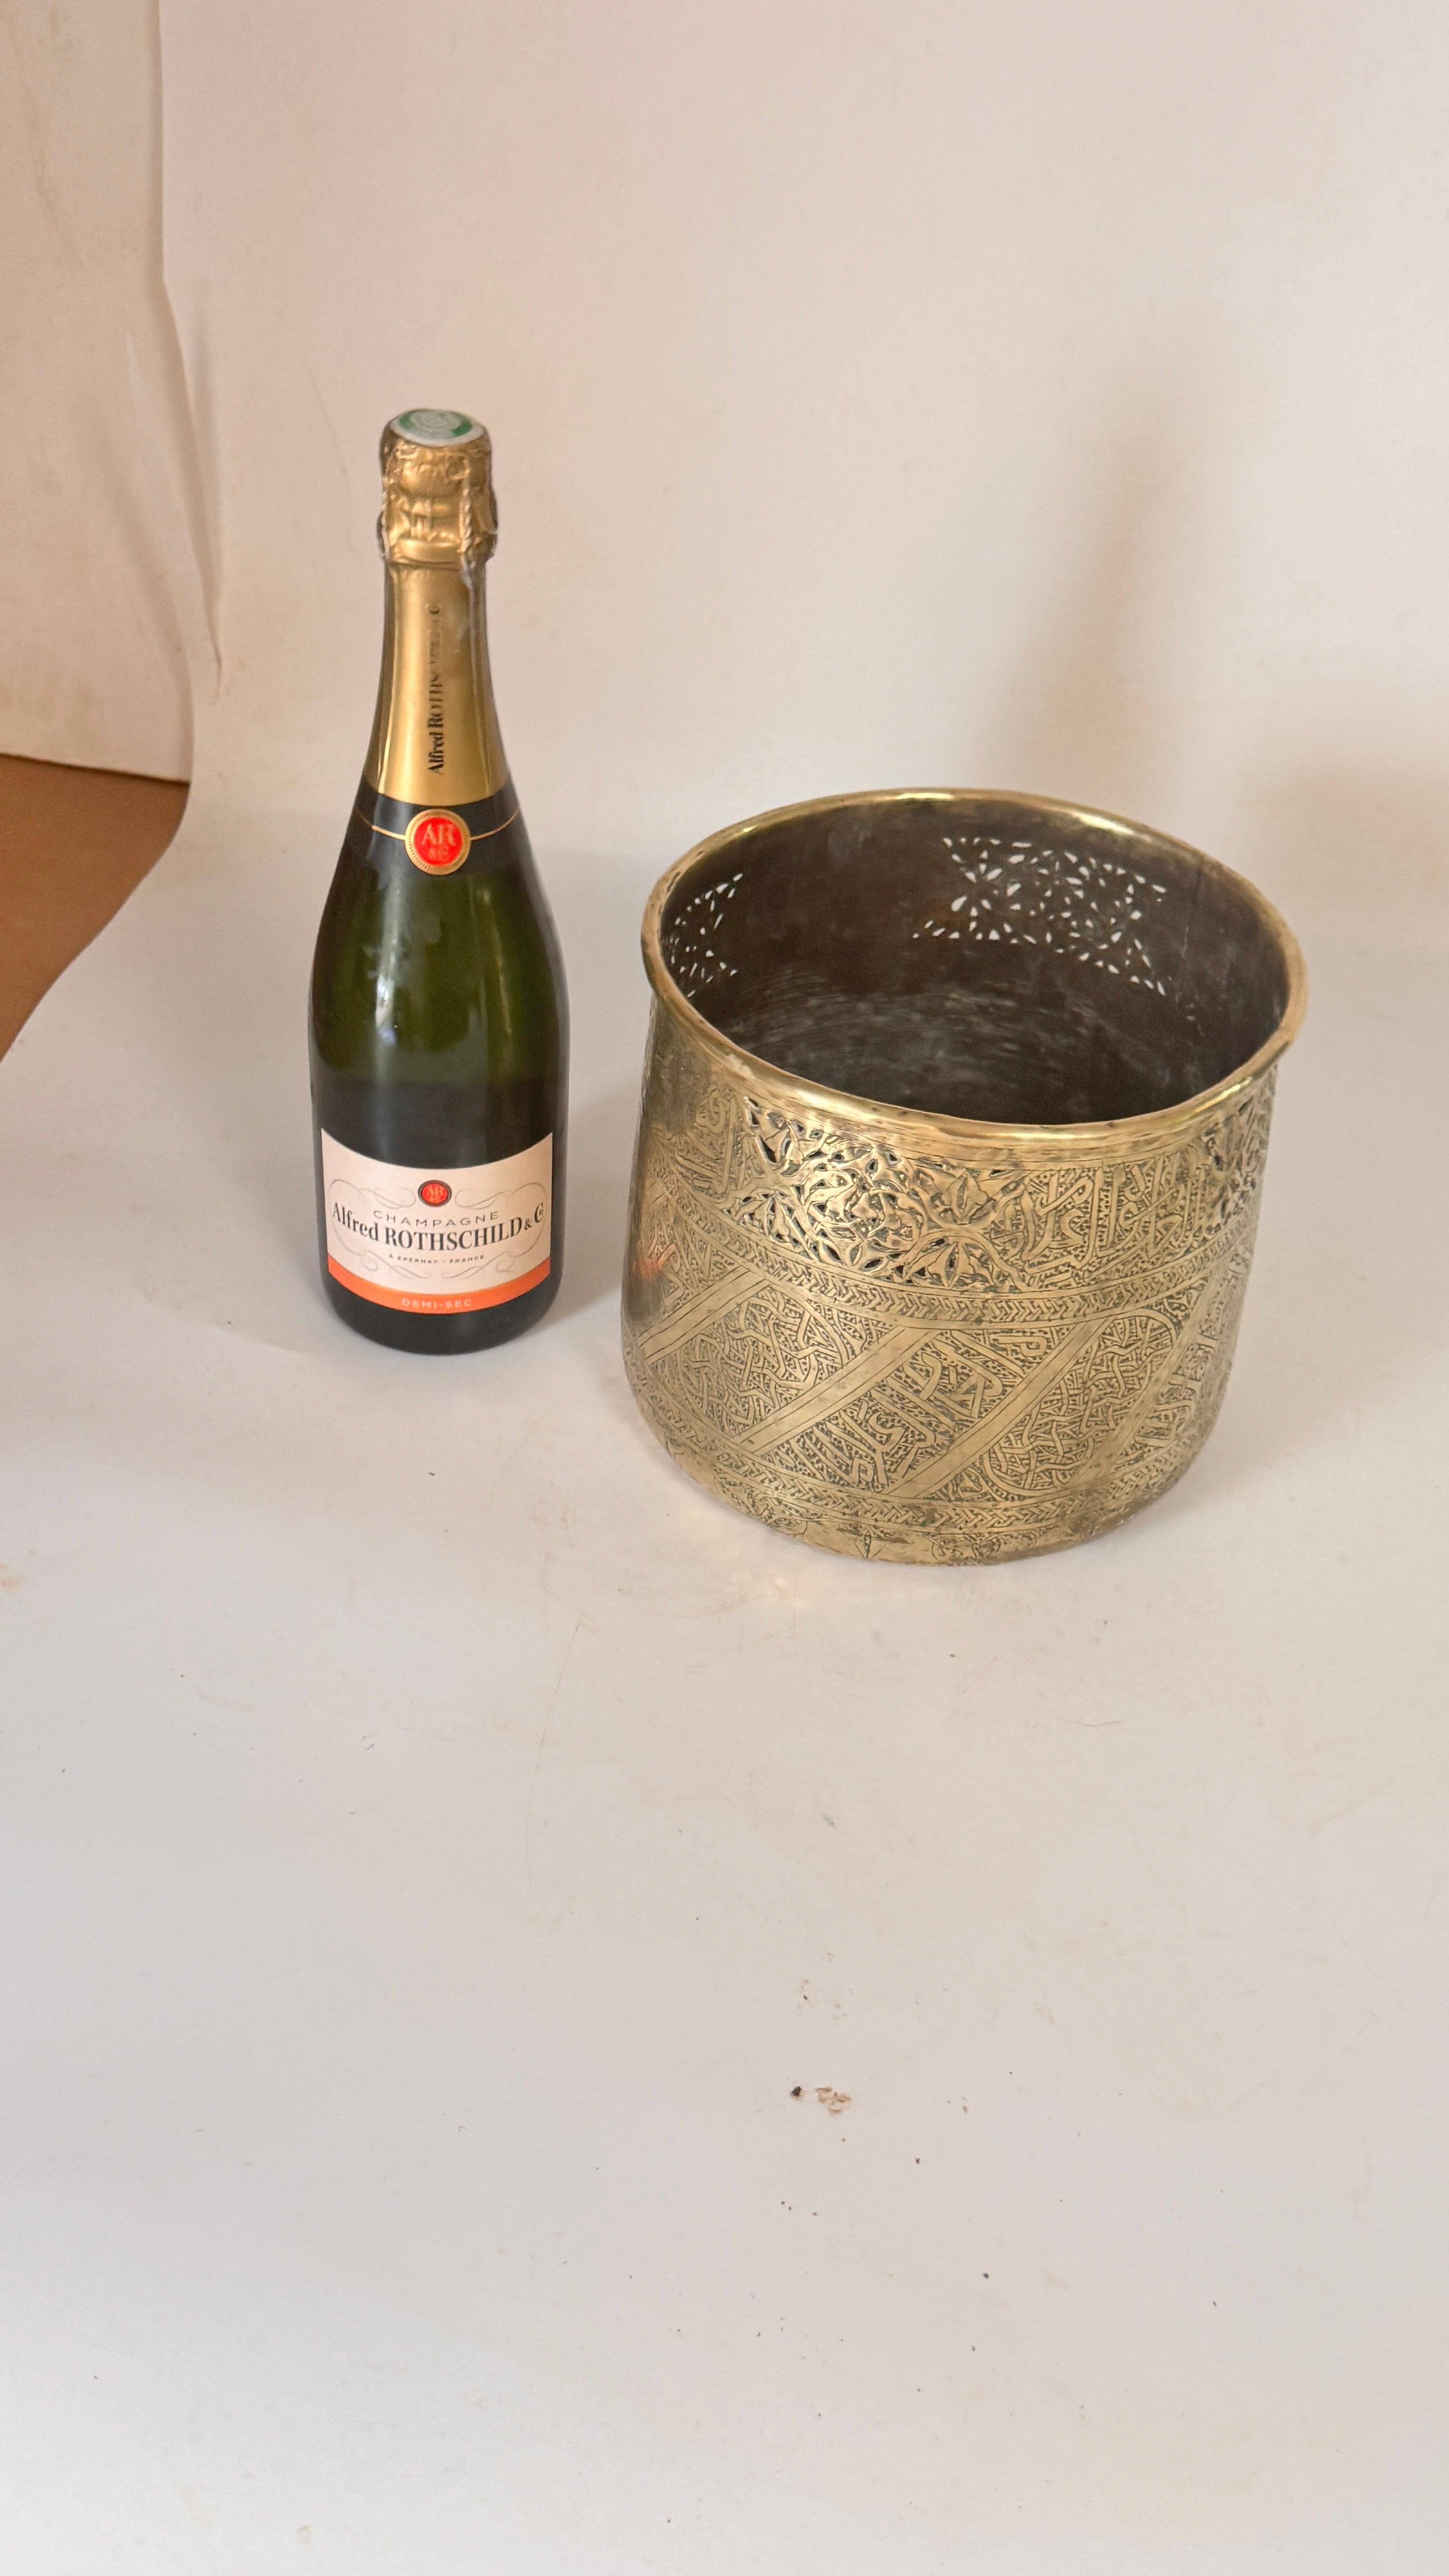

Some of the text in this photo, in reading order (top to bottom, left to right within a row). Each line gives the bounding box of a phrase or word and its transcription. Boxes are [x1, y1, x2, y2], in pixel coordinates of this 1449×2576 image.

[428, 732, 444, 775] Alfred
[422, 823, 455, 845] AR
[333, 1202, 379, 1242] Alfred
[385, 1217, 522, 1251] ROTHSCHILD
[373, 1210, 499, 1227] CHAMPAGNE
[450, 1255, 484, 1263] FRANCE
[401, 1298, 472, 1309] DEMI-SEC
